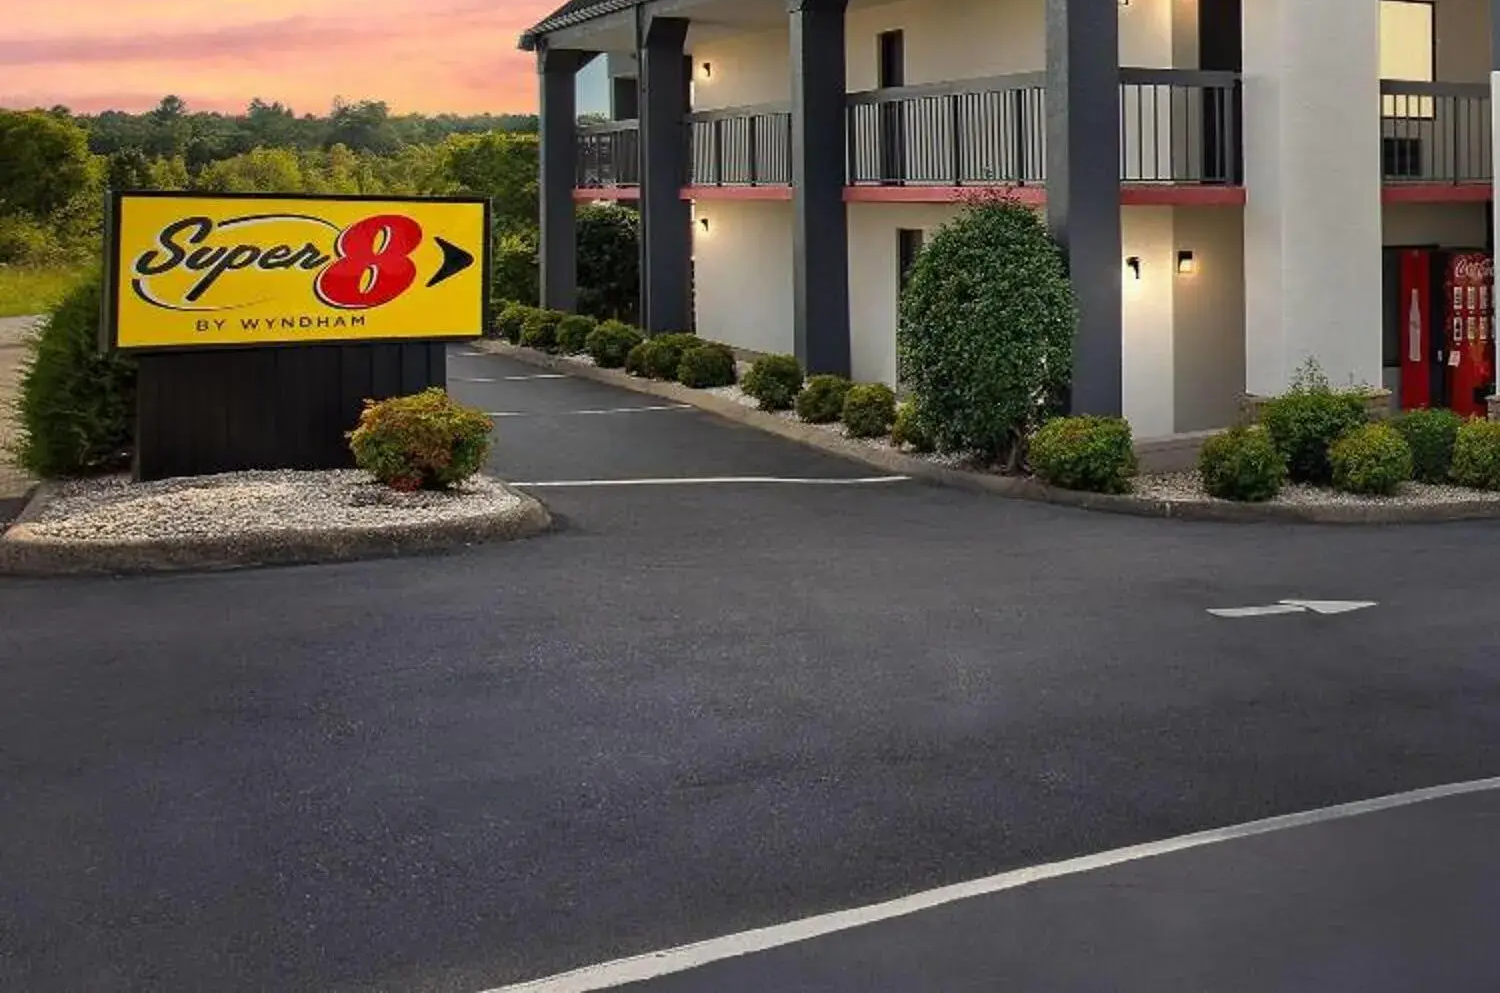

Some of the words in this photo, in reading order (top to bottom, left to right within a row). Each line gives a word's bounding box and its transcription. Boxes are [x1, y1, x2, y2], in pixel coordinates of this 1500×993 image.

[135, 216, 329, 301] Super
[313, 214, 424, 309] 8
[196, 318, 226, 332] BY
[240, 316, 365, 330] WYNDHAM
